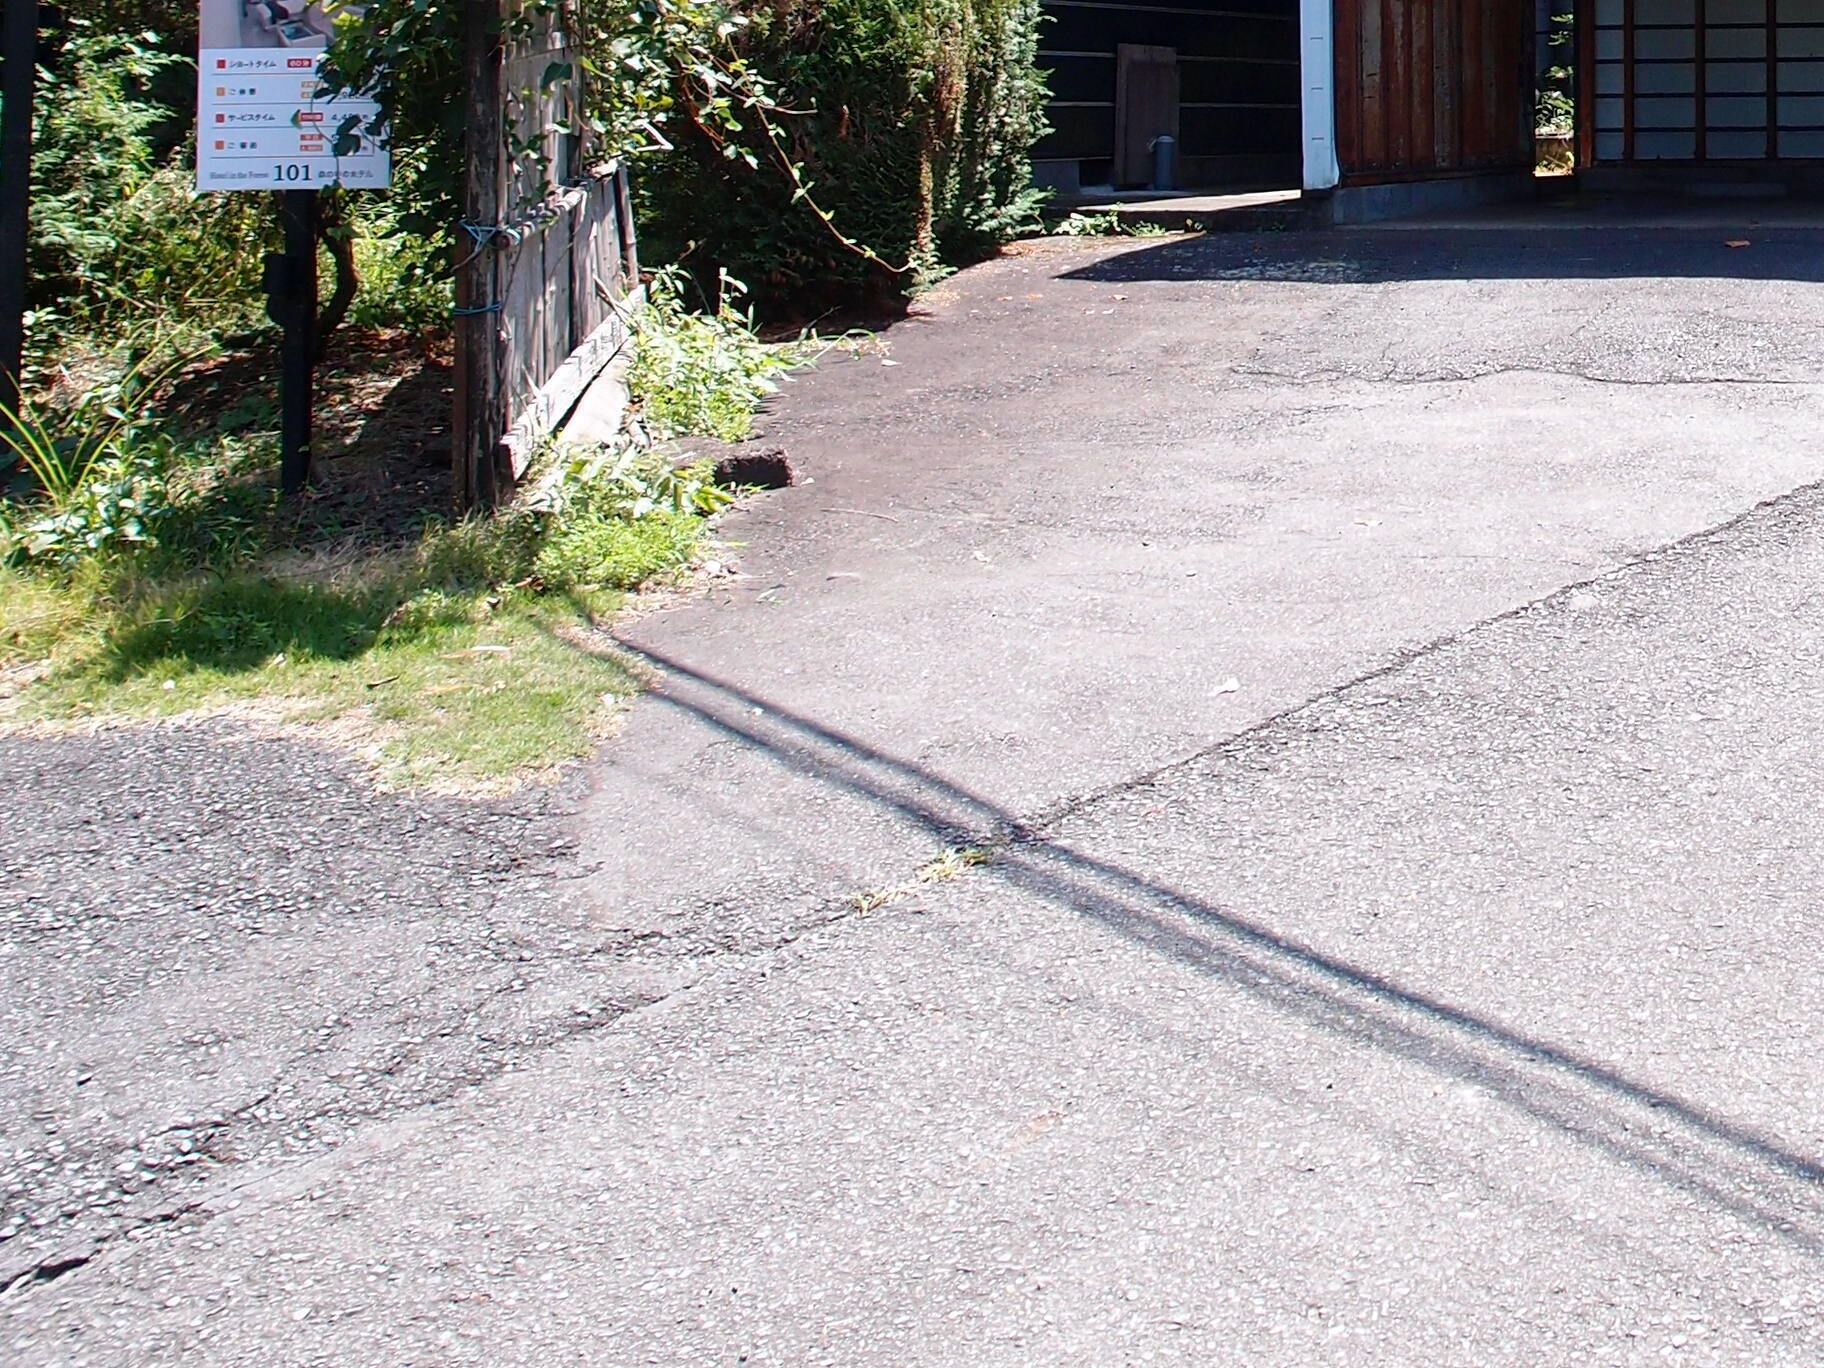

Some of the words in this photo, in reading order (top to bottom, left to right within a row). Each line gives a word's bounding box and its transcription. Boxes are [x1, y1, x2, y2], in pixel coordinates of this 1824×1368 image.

[229, 59, 277, 69] ショートタイム
[227, 113, 276, 122] サービスタイム
[273, 164, 313, 181] 101
